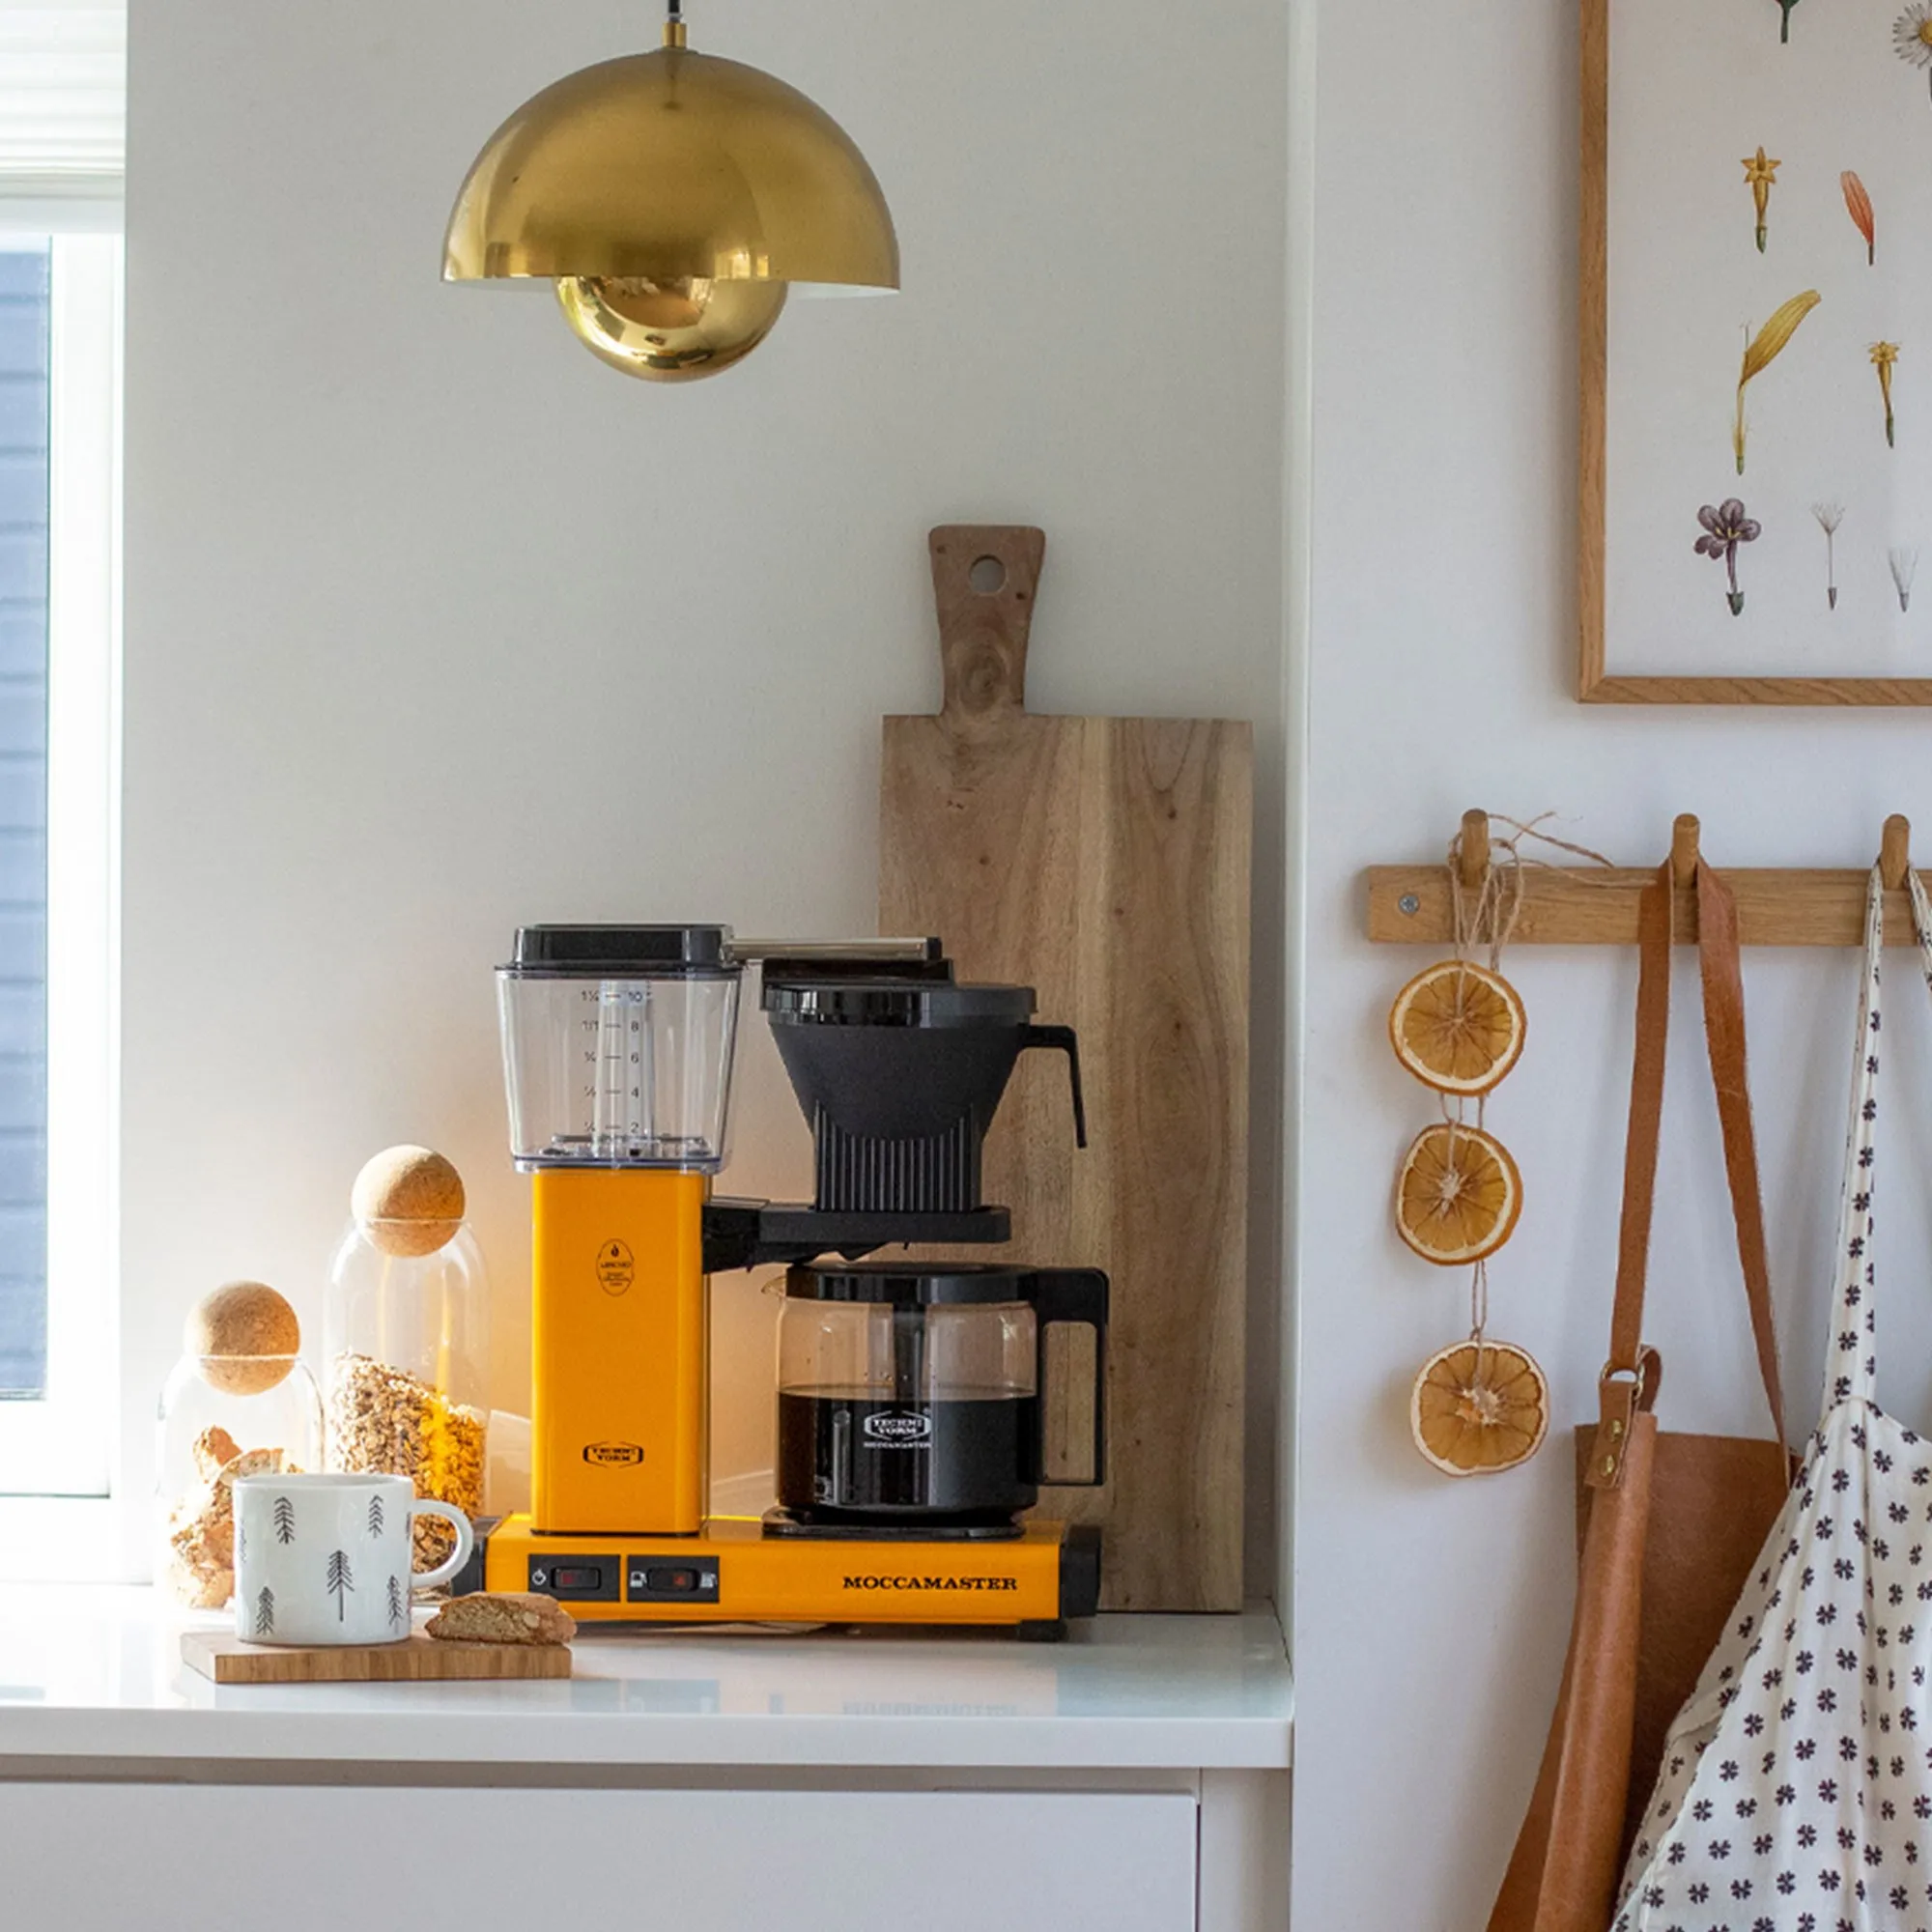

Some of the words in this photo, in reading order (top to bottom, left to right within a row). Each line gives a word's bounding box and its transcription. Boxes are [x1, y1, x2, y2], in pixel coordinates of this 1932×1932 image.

[631, 1086, 639, 1098] 4
[631, 1122, 639, 1133] 2
[842, 1576, 1018, 1591] MOCCAMASTER
